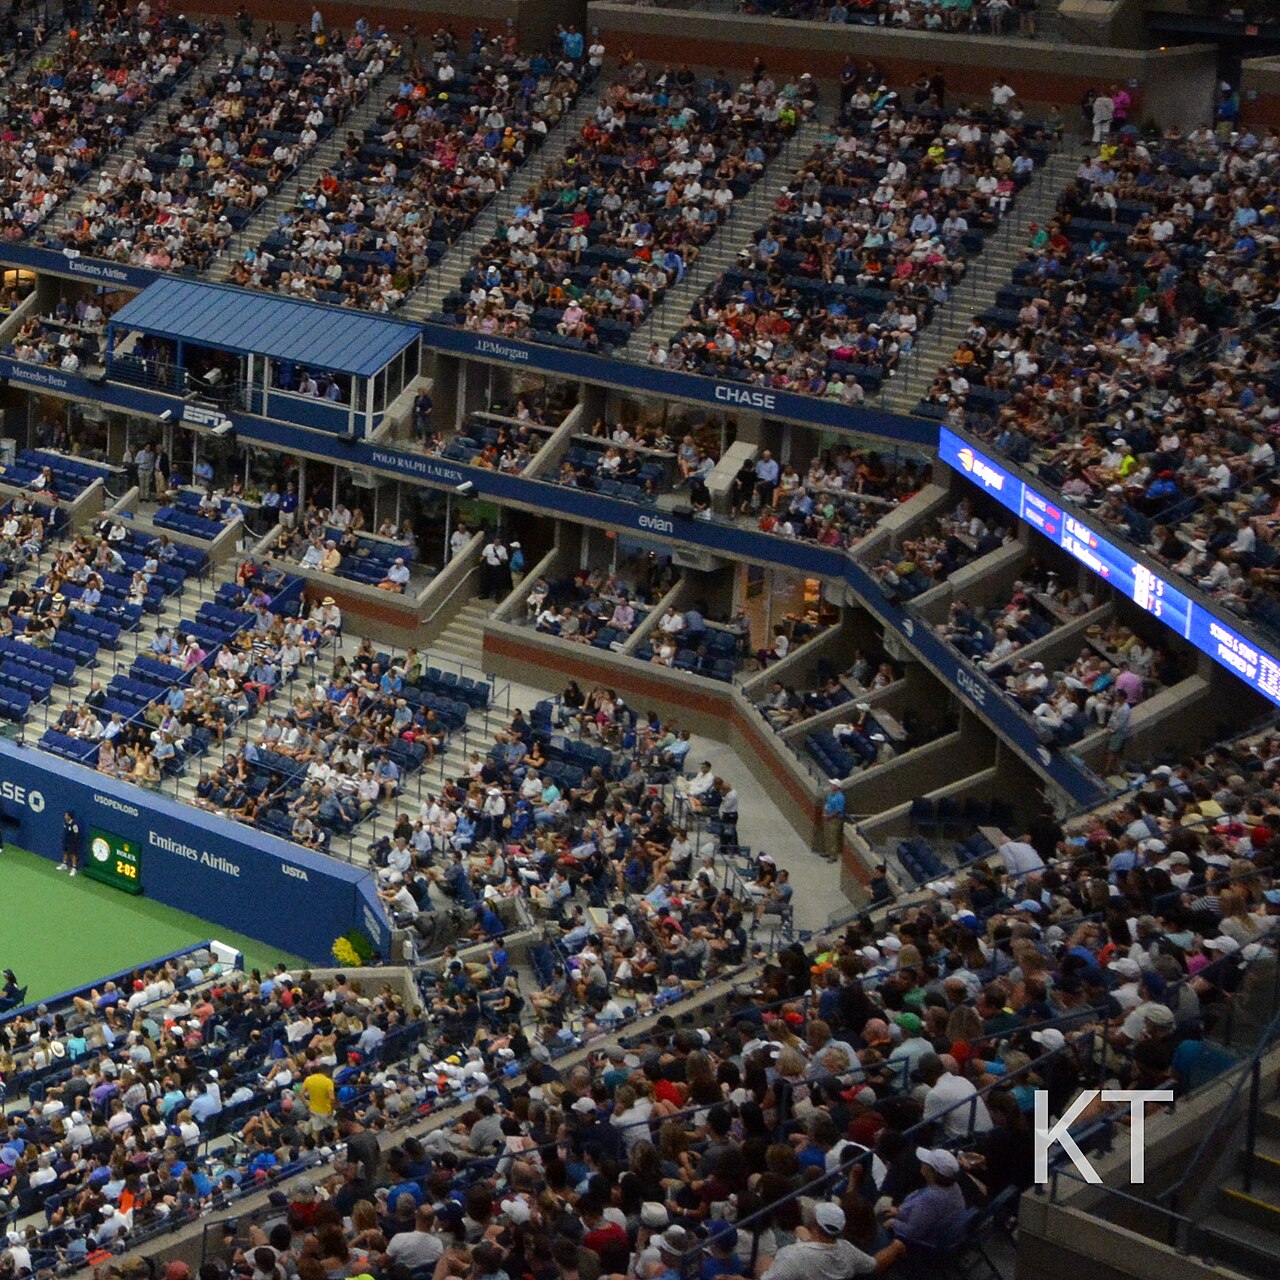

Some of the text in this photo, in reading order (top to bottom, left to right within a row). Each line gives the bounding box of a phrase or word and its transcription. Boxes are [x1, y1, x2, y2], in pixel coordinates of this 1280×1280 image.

[69, 260, 127, 281] Emirates Airline
[475, 339, 529, 360] J.P.Morgan
[12, 367, 67, 387] Mercedes-Benz
[715, 386, 775, 410] CHASE
[182, 405, 226, 426] ESPN
[373, 452, 463, 480] POLO RALPH LAUREN
[639, 515, 673, 533] evian
[957, 668, 985, 706] CHASE
[94, 793, 139, 817] USOPEN.ORG
[116, 849, 137, 862] ROLEX
[148, 831, 240, 878] Emirates Airline
[116, 861, 137, 878] 2:02
[282, 864, 309, 882] USTA
